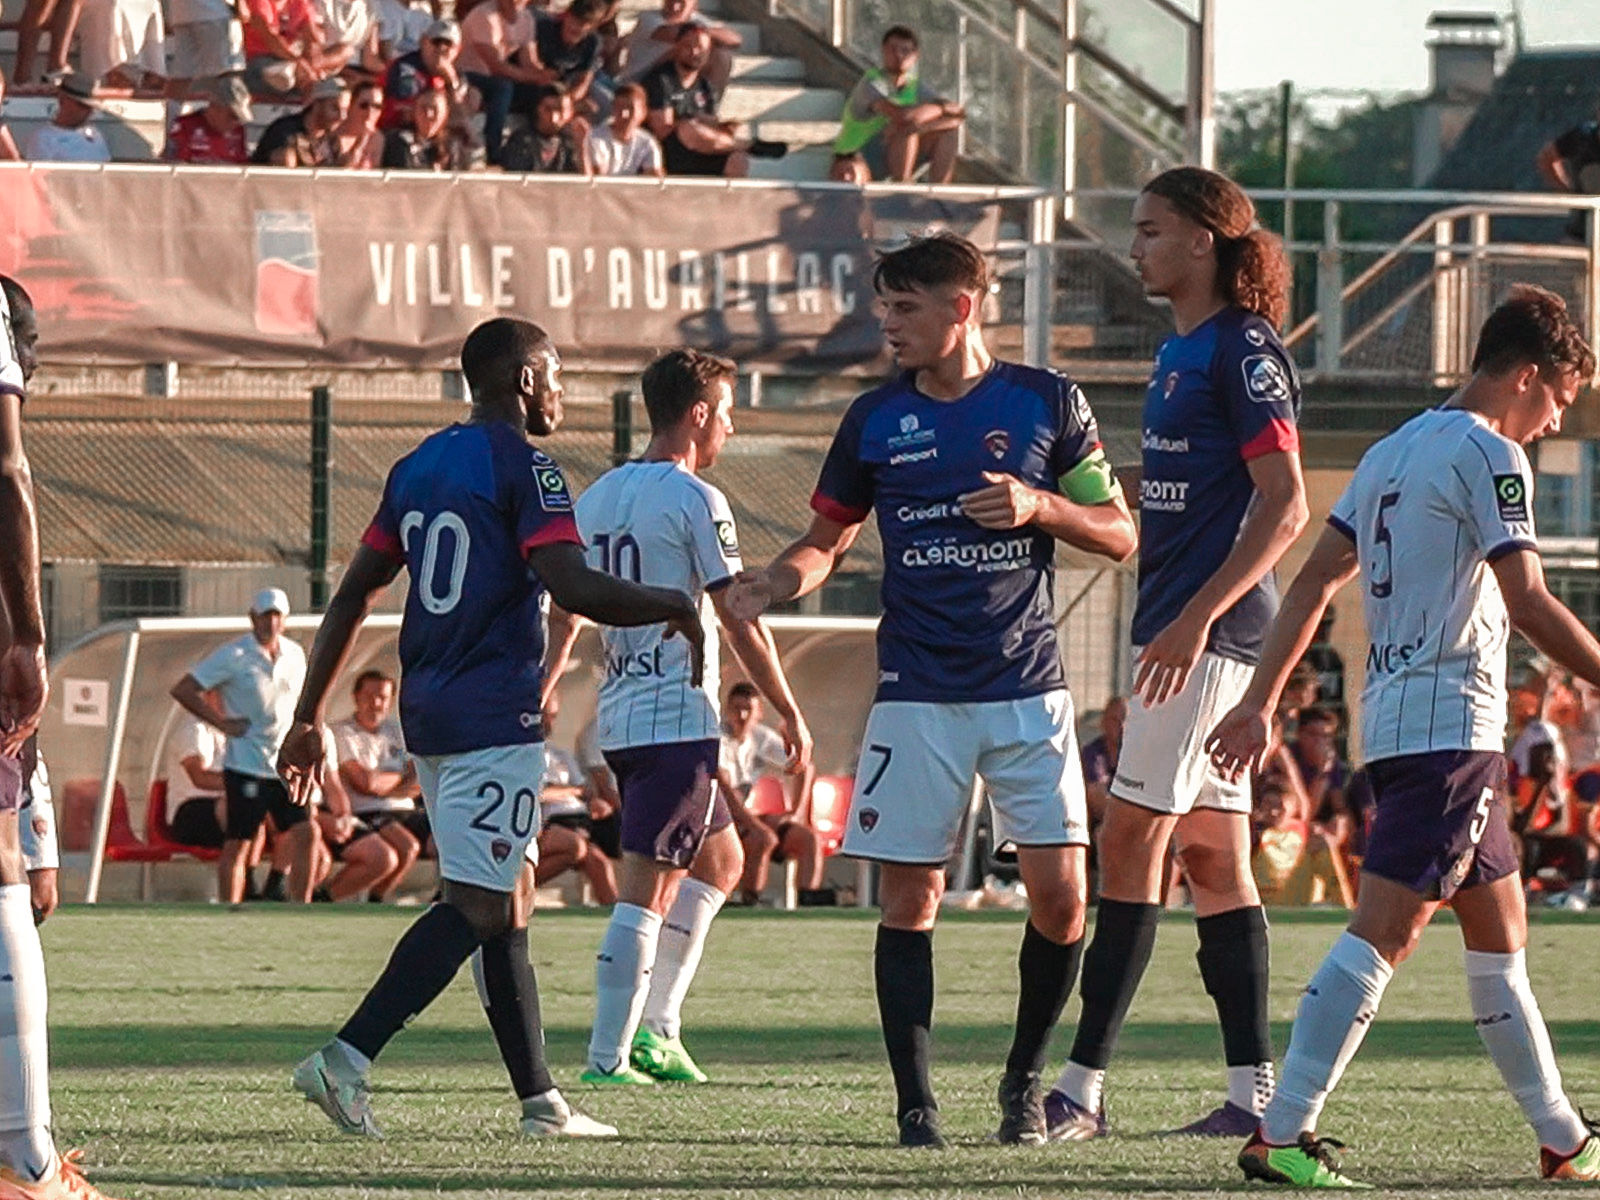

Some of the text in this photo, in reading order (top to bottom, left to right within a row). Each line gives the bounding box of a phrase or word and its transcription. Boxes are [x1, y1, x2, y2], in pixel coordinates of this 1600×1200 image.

[368, 241, 857, 316] VILLE D'AURILLAC
[1370, 491, 1401, 599] 5
[862, 743, 893, 797] 7
[469, 780, 536, 839] 20
[1469, 786, 1495, 845] 5
